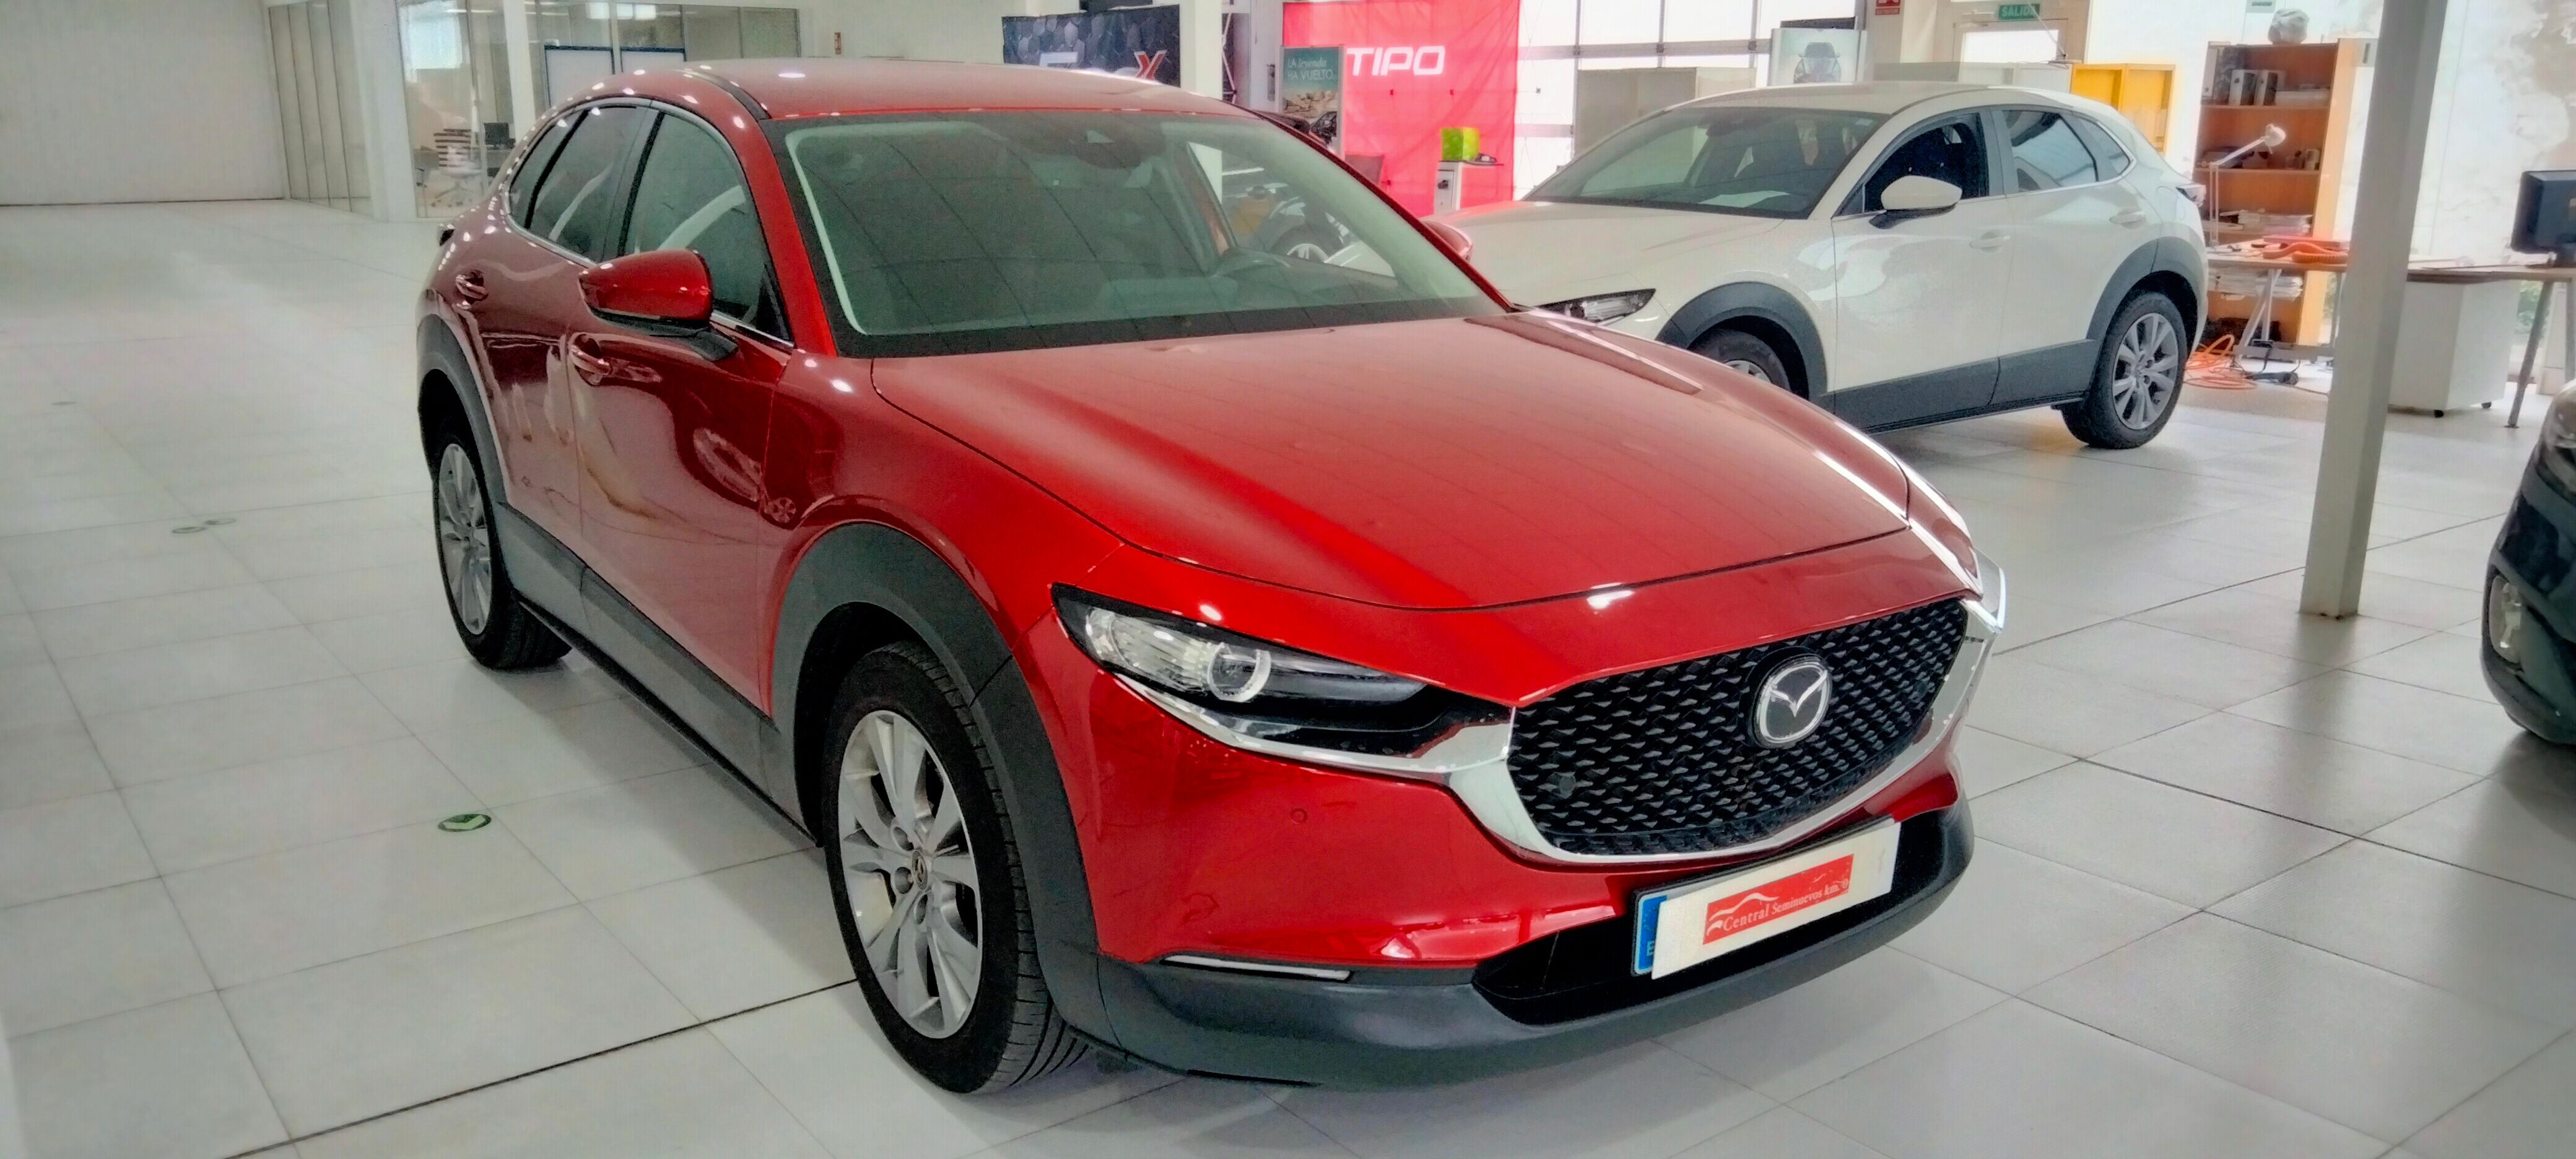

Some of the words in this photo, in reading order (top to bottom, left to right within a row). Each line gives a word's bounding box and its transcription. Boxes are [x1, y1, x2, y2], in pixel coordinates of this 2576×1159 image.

[2001, 5, 2036, 17] SALIDA
[1347, 46, 1445, 76] TIPO
[1300, 69, 1333, 80] VUELTO
[1723, 904, 1770, 931] Central
[1772, 888, 1822, 915] Seminuevos
